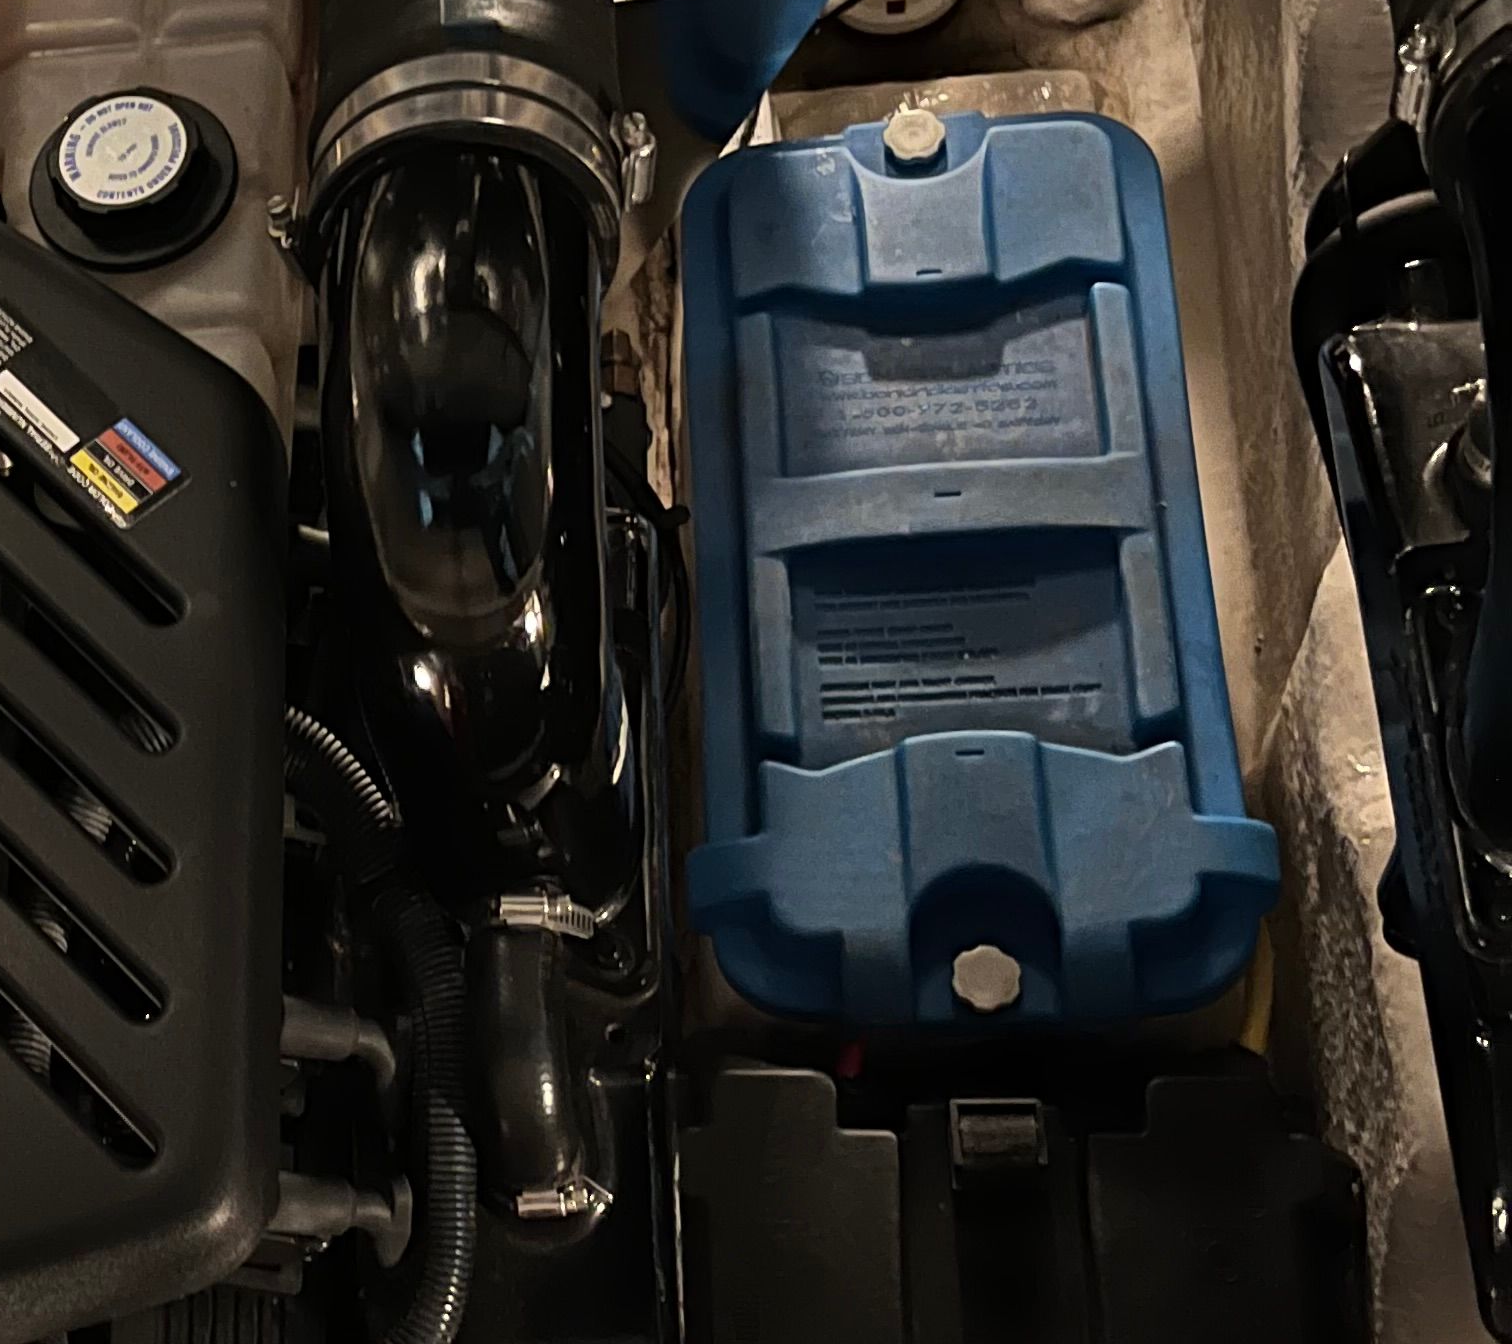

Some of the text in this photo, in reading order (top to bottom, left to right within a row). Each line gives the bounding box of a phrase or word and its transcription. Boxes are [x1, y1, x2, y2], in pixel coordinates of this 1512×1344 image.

[64, 133, 81, 182] WARNING
[115, 101, 135, 111] OPEN
[96, 186, 144, 199] CONTENTS
[146, 165, 172, 189] UNDER
